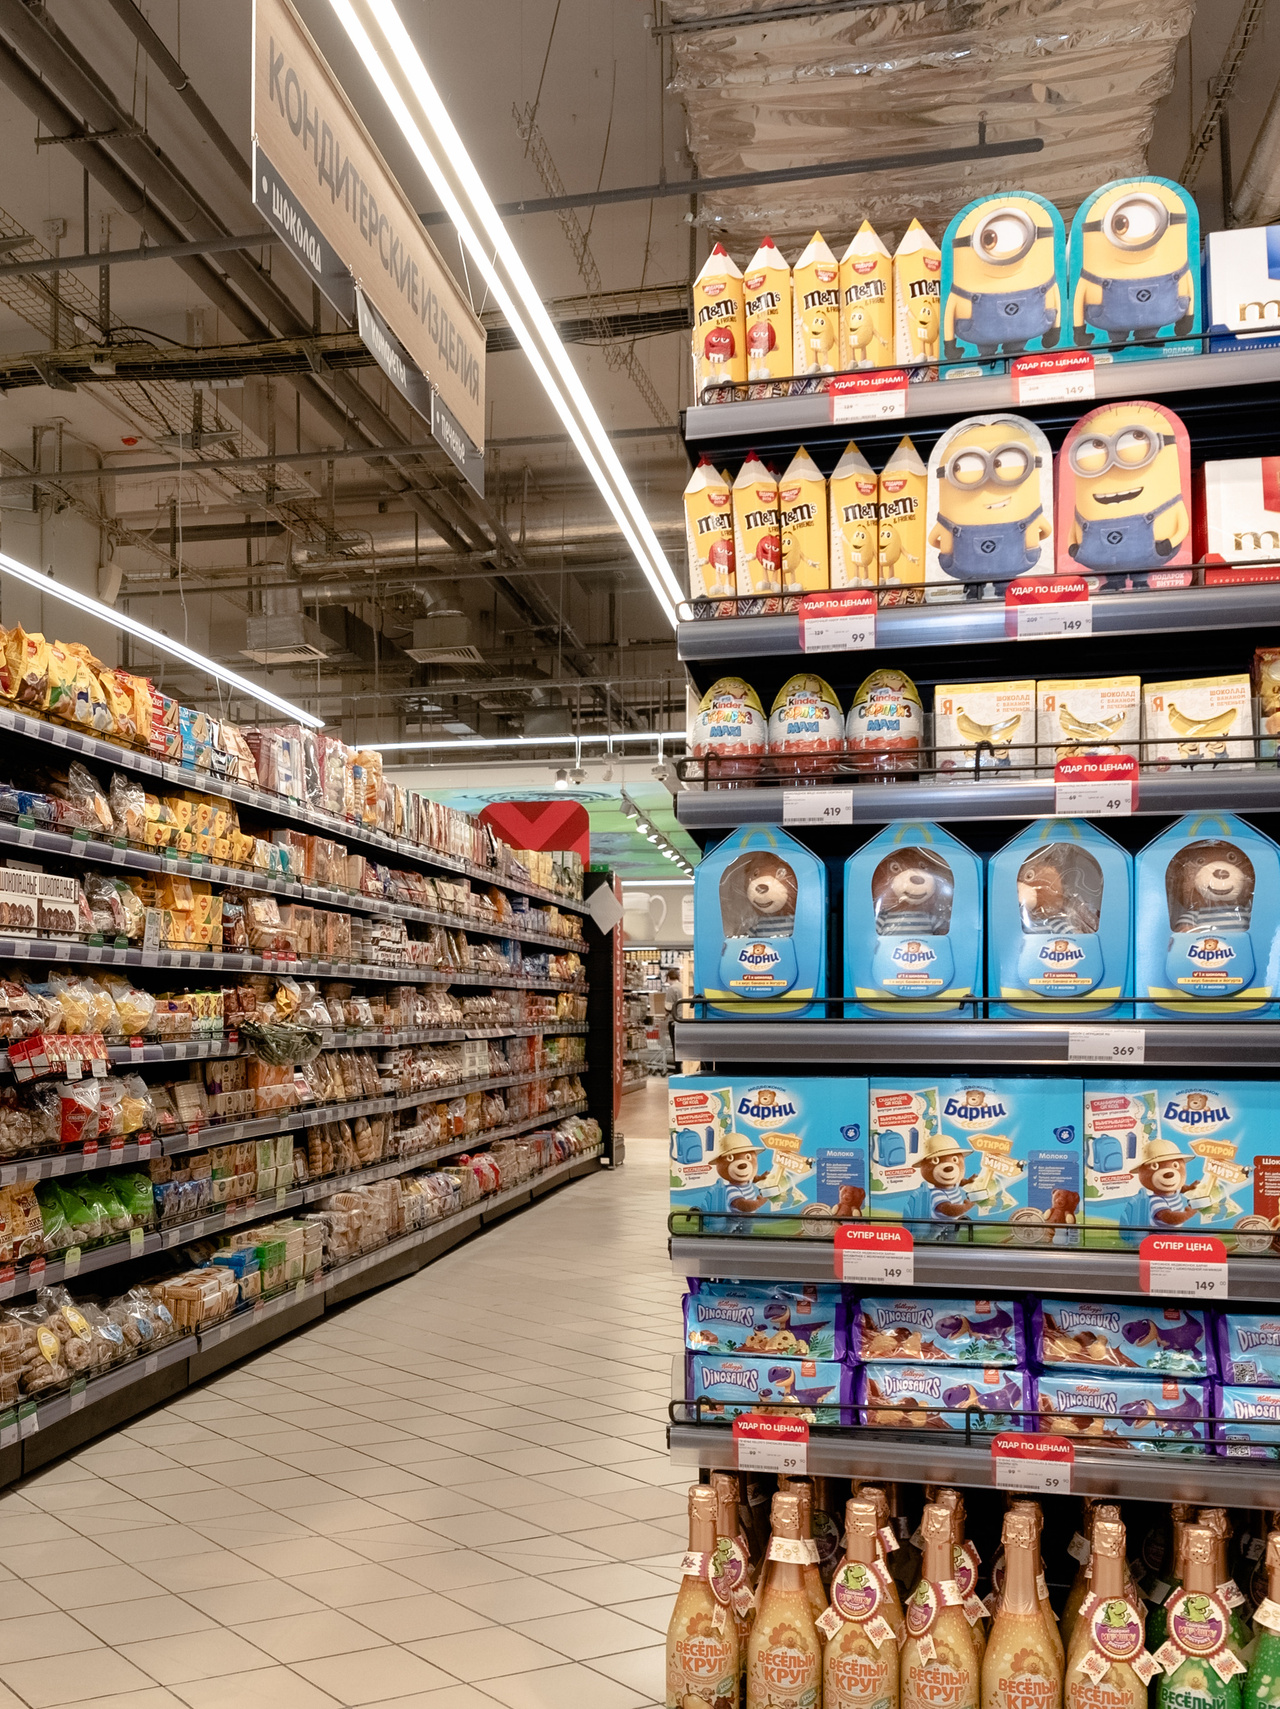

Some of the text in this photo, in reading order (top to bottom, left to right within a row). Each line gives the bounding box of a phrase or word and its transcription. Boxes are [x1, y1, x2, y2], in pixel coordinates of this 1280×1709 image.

[270, 36, 479, 405] КОНДИТЕРСКИЕ ИЗДЕЛИЯ
[272, 182, 322, 273] шоколад
[371, 324, 407, 388] конфеты
[1016, 357, 1090, 370] УДАР ПО ЦЕНАМ!
[834, 376, 904, 390] УДАР ПО ЦЕНАМ!
[1065, 385, 1084, 396] 149
[882, 405, 895, 413] 99
[441, 413, 465, 464] печенье
[1152, 572, 1185, 581] ПОДАРОК
[1156, 579, 1185, 588] ВНУТРИ
[1011, 583, 1084, 595] УДАР ПО ЦЕНАМ!
[803, 598, 872, 610] УДАР ПО ЦЕНАМ!
[1063, 620, 1081, 630] 149
[852, 633, 865, 642] 99
[870, 693, 900, 703] Kinder
[996, 694, 1030, 702] ШОКОЛАД
[1100, 691, 1136, 699] ШОКОЛАД
[1209, 688, 1246, 697] ШОКОЛАД
[712, 700, 742, 709] Kinder
[788, 696, 817, 706] Kinder
[943, 699, 953, 715] Я
[1045, 696, 1056, 711] Я
[1153, 696, 1163, 712] Я
[710, 725, 742, 738] MAXI
[787, 721, 819, 734] MAXI
[867, 718, 900, 731] MAXI
[1060, 762, 1134, 774] УДАР ПО ЦЕНАМ!
[824, 808, 841, 816] 419
[1106, 800, 1121, 810] 49
[739, 950, 779, 965] Барни
[892, 948, 936, 963] Барни
[1039, 946, 1084, 962] Барни
[1188, 945, 1234, 961] Барни
[1113, 1046, 1134, 1056] 369
[738, 1098, 796, 1120] Барни
[944, 1099, 1006, 1121] Барни
[1163, 1102, 1230, 1125] Барни
[768, 1138, 799, 1149] ОТКРОЙ
[976, 1139, 1010, 1151] ОТКРОЙ
[1198, 1145, 1234, 1157] ОТКРОЙ
[776, 1155, 803, 1173] МИР!
[984, 1157, 1014, 1176] МИР!
[1207, 1163, 1239, 1182] МИР!
[847, 1230, 901, 1241] СУПЕР ЦЕНА
[1153, 1241, 1213, 1252] СУПЕР ЦЕНА
[884, 1268, 902, 1277] 149
[1195, 1281, 1215, 1290] 149
[698, 1304, 754, 1327] DINOSAURS
[878, 1308, 933, 1329] DINOSAURS
[1060, 1309, 1120, 1333] DINOSAURS
[701, 1367, 759, 1391] DINOSAURS
[884, 1376, 941, 1398] DINOSAURS
[1056, 1391, 1118, 1414] DINOSAURS
[738, 1422, 758, 1430] УДАР
[774, 1425, 804, 1433] ЦЕНАМ!
[1036, 1444, 1070, 1452] ЦЕНАМ!
[784, 1459, 796, 1467] 59
[1045, 1479, 1059, 1487] 59
[676, 1637, 732, 1659] ВЕСЁЛЫЙ
[682, 1655, 729, 1675] КРУГ
[757, 1648, 816, 1669] ВЕСЁЛЫЙ
[829, 1656, 888, 1678] ВЕСЁЛЫЙ
[764, 1665, 810, 1686] КРУГ
[909, 1664, 970, 1685] ВЕСЁЛЫЙ
[835, 1675, 882, 1696] КРУГ
[916, 1682, 963, 1703] КРУГ
[998, 1675, 1058, 1696] ВЕСЁЛЫЙ
[1071, 1679, 1134, 1704] ВЕСЁЛЫЙ
[1161, 1692, 1227, 1708] ВЕСЁЛЫЙ
